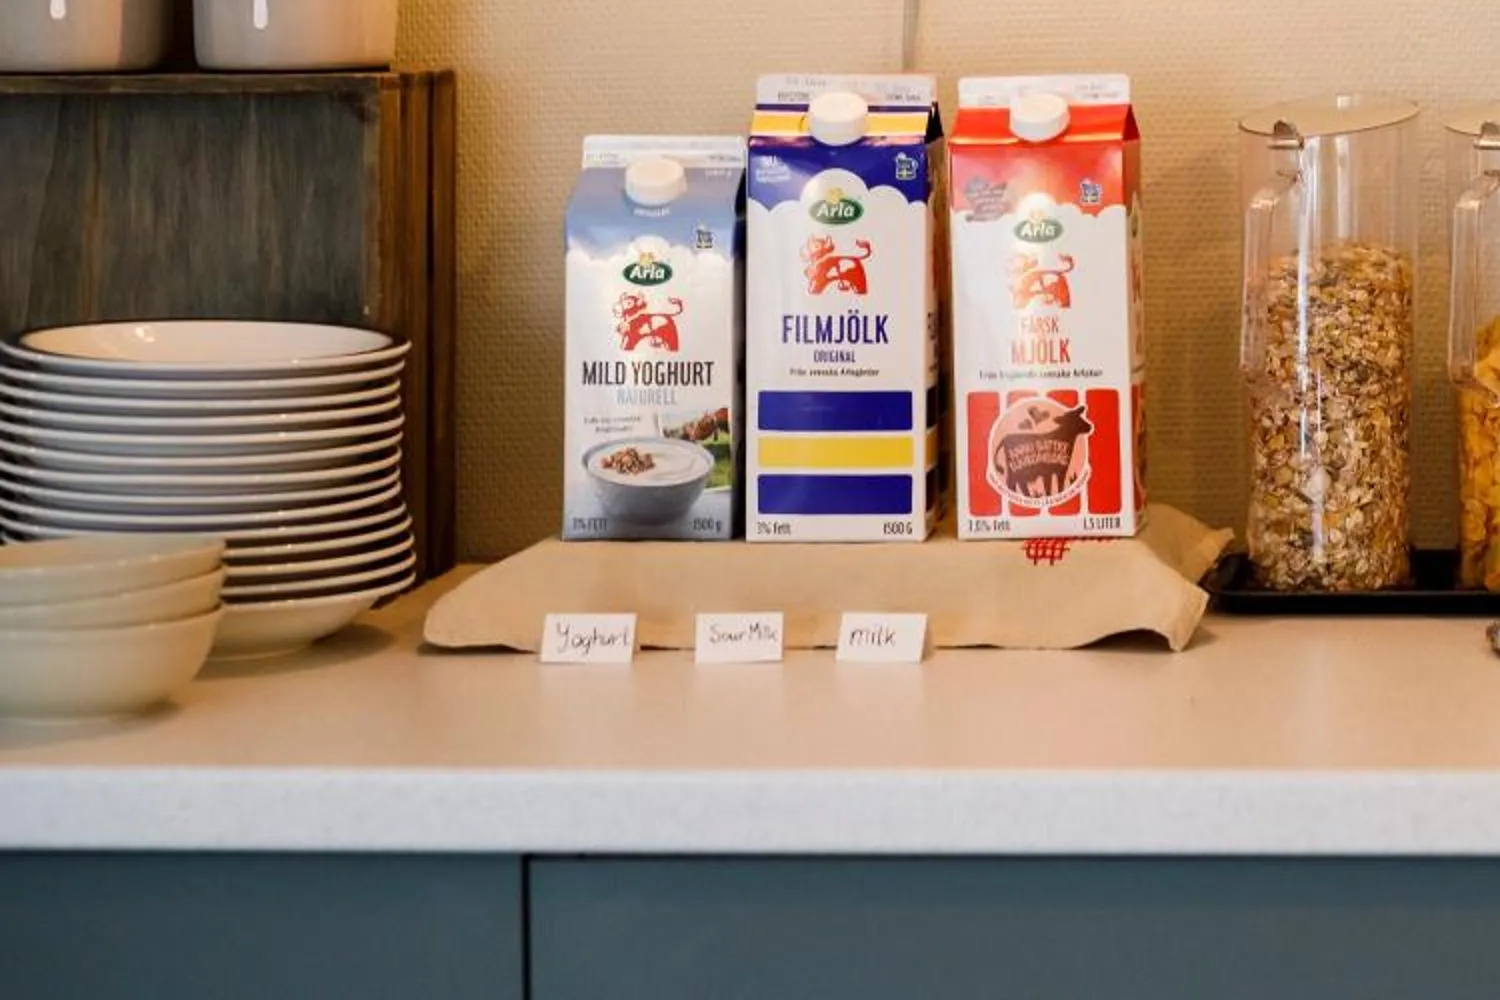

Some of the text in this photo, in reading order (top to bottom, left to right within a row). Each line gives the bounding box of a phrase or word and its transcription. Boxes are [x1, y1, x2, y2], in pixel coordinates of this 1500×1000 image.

[816, 203, 855, 217] Arla
[1020, 222, 1057, 237] Arla
[629, 265, 666, 280] Arla
[782, 309, 889, 344] FILMJÖLK
[581, 361, 715, 386] MILD YOGHURT
[882, 521, 905, 534] 1500
